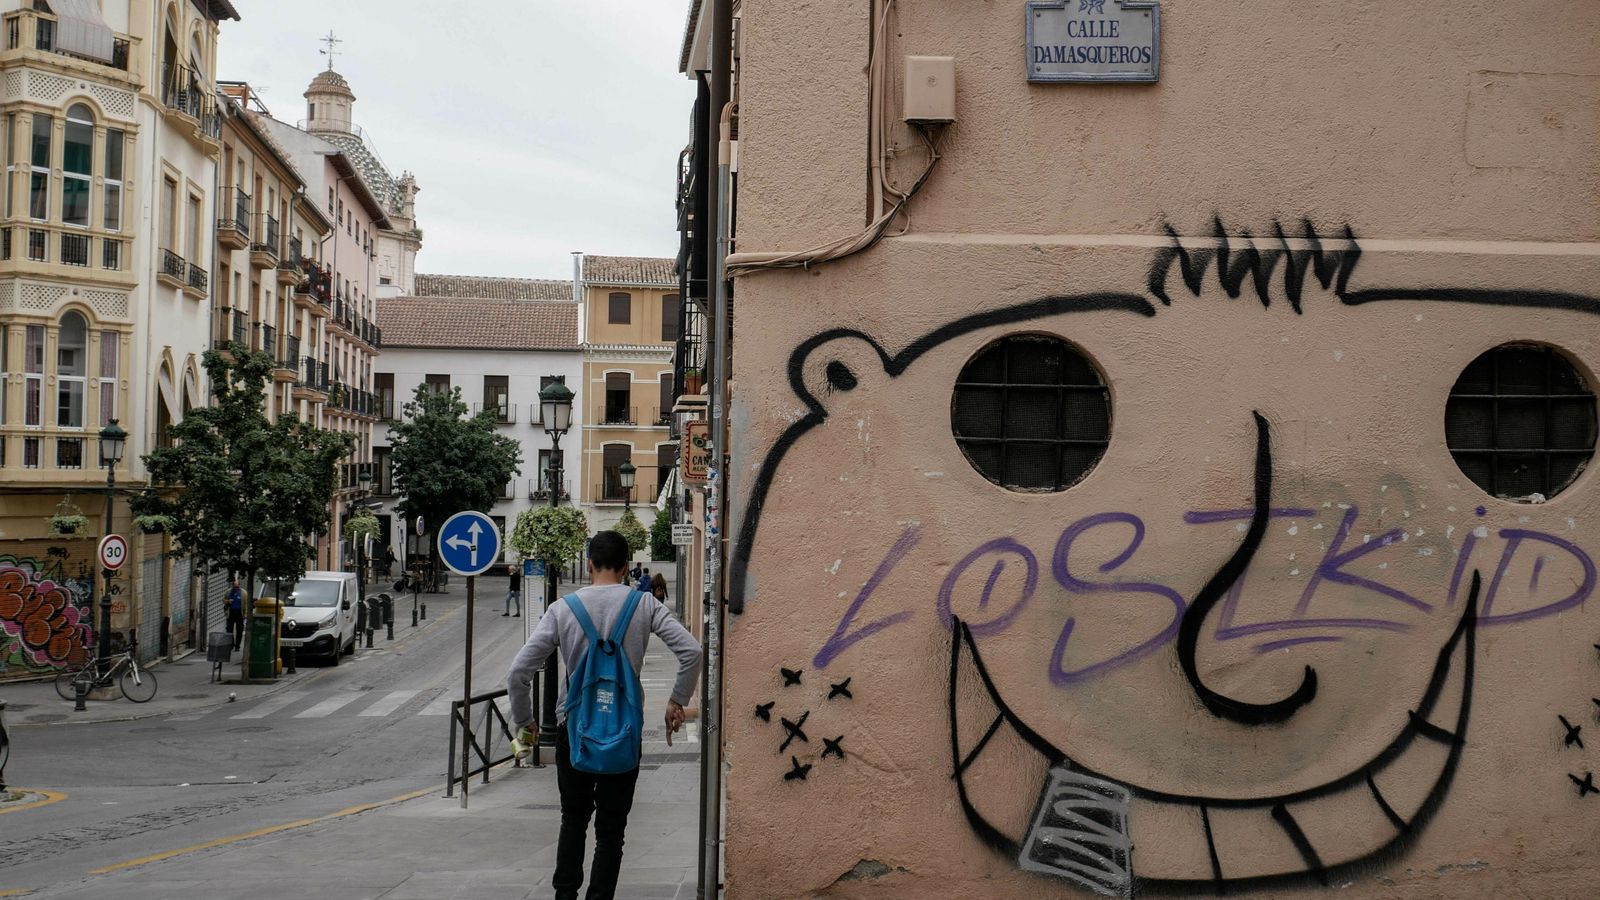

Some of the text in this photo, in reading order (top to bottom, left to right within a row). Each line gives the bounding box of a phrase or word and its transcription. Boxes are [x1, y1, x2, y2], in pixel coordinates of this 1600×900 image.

[1067, 20, 1120, 38] CALLE
[1034, 46, 1151, 64] DAMASQUEROS
[106, 546, 122, 558] 30
